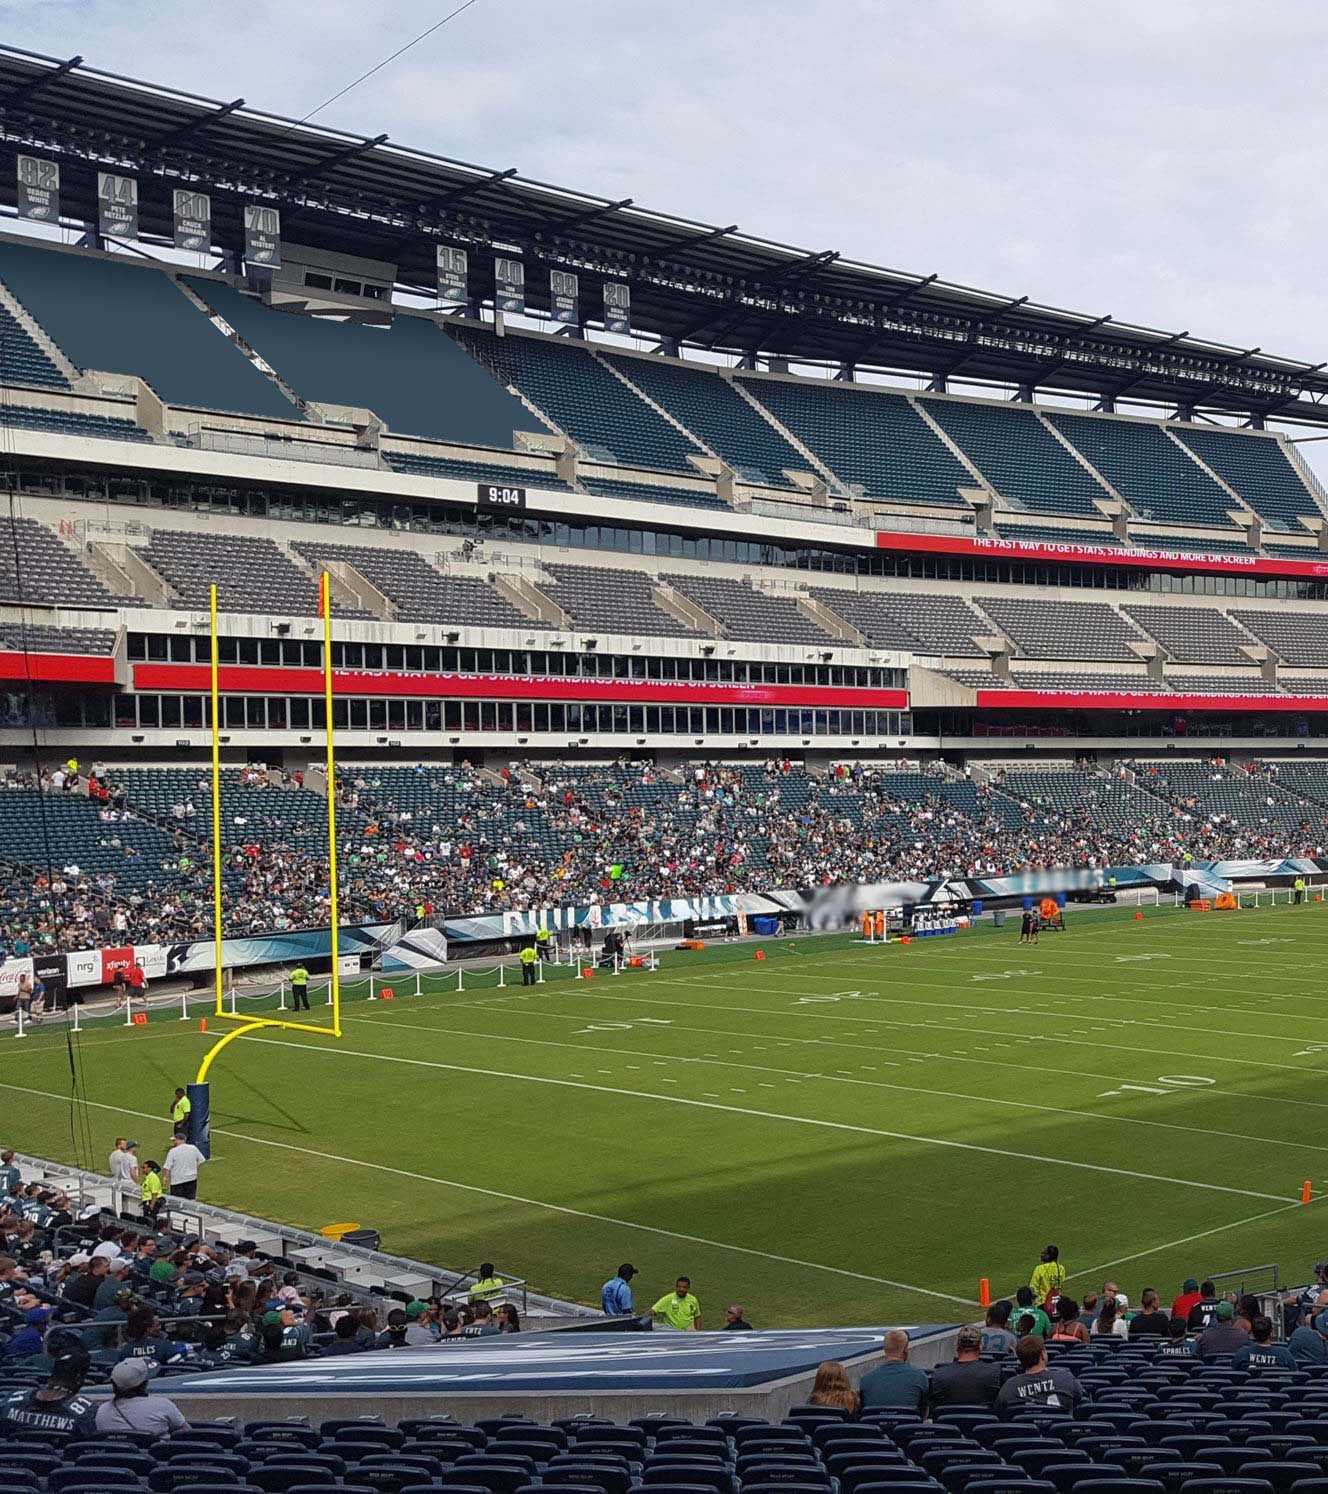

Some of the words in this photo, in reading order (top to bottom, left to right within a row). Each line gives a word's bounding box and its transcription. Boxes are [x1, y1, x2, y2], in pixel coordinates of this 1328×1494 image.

[102, 175, 134, 206] 44
[247, 205, 277, 235] 70
[440, 247, 465, 274] 15
[498, 260, 521, 285] 40
[605, 283, 629, 308] 20
[489, 487, 519, 504] 9:04
[972, 538, 992, 548] THE
[994, 539, 1016, 550] FAST
[1019, 541, 1040, 551] WAY
[1042, 543, 1055, 552] TO
[1057, 544, 1075, 554] GET
[1107, 547, 1158, 560] STANDINGS
[1159, 552, 1178, 561] AND
[1180, 553, 1206, 562] MORE
[1208, 554, 1221, 564] ON
[1222, 555, 1256, 566] SCREEN
[77, 961, 94, 973] nrg
[1120, 1074, 1216, 1096] 10
[1250, 1353, 1276, 1364] WENTZ
[1017, 1379, 1055, 1398] WENTZ
[70, 1397, 92, 1415] 81
[7, 1408, 75, 1430] MATTHEWS
